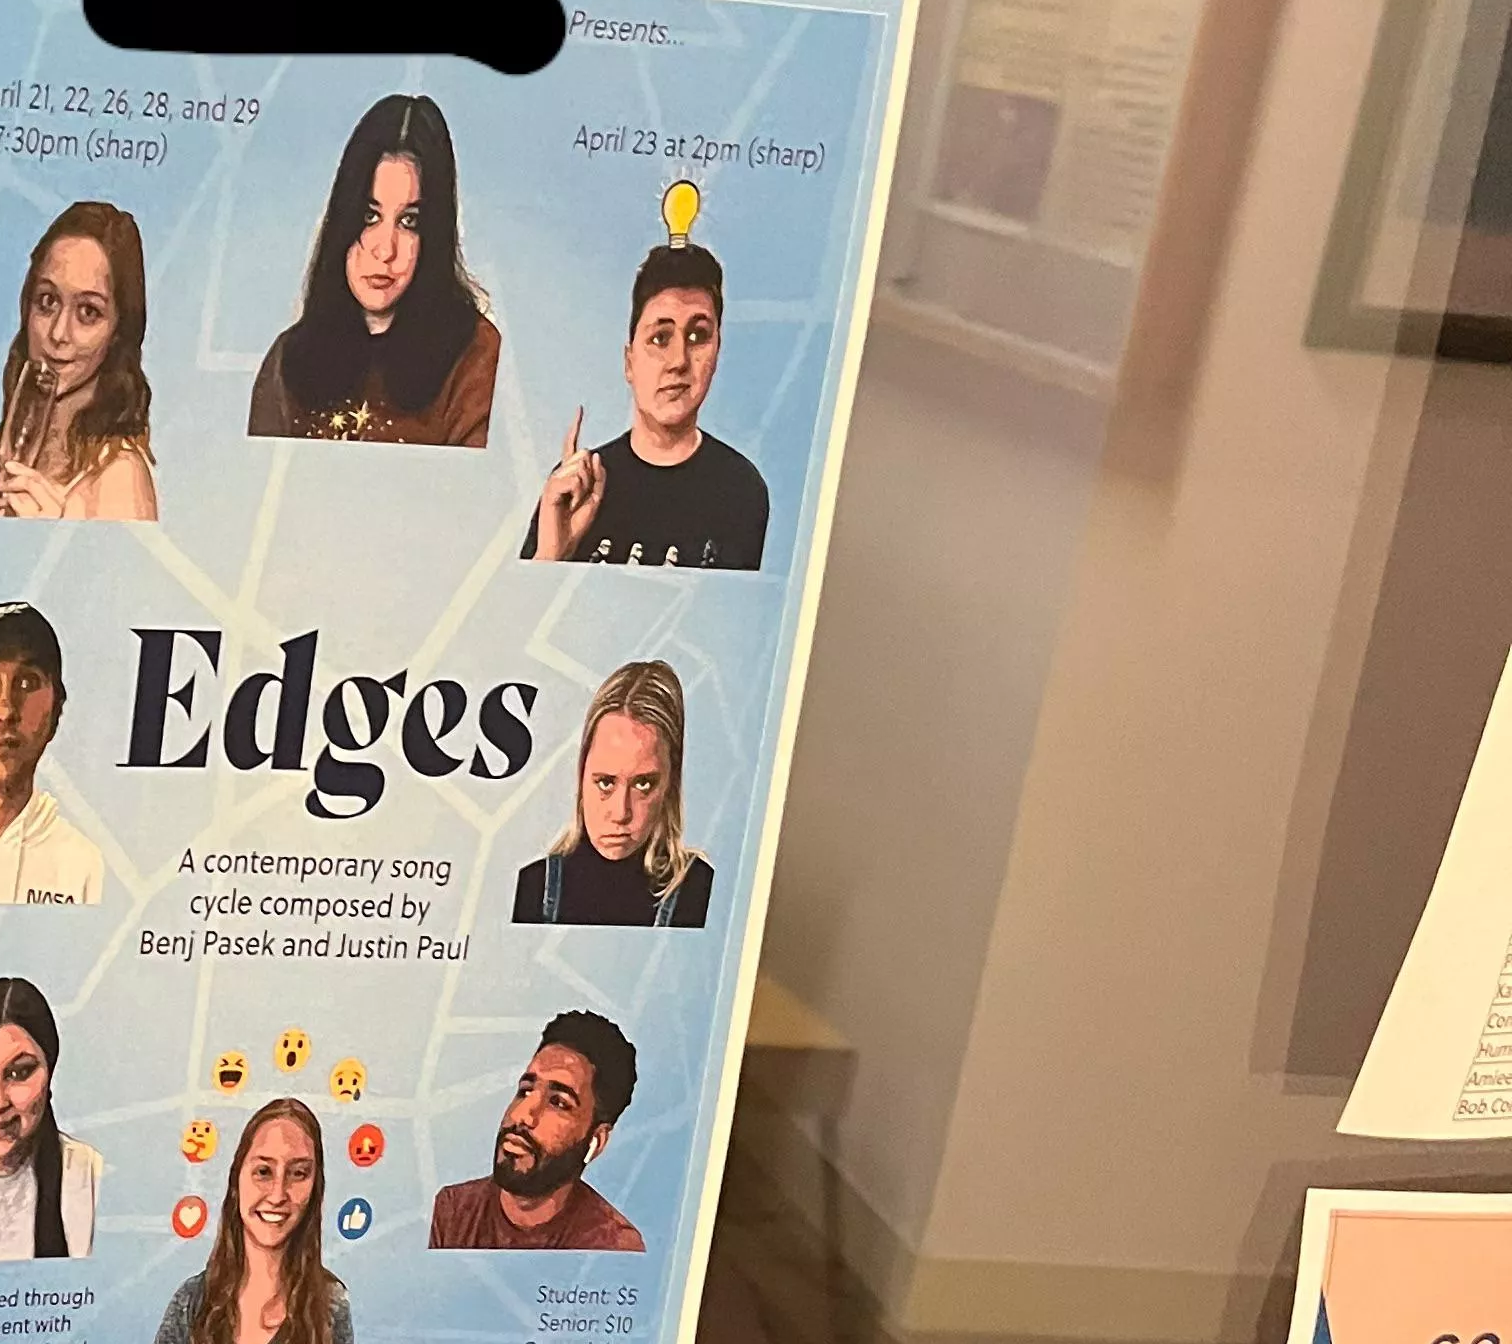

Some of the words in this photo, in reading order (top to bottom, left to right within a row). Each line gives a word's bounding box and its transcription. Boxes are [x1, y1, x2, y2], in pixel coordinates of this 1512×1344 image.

[569, 10, 685, 47] Presents...
[29, 84, 54, 113] 21,
[64, 86, 93, 116] 22,
[103, 88, 132, 119] 26,
[142, 91, 172, 122] 28,
[182, 95, 227, 122] and
[232, 97, 260, 126] 29
[87, 129, 168, 168] (sharp)
[573, 124, 625, 157] April
[632, 130, 657, 155] 23
[664, 136, 686, 158] at
[690, 136, 742, 167] 2pm
[748, 136, 825, 174] (sharp)
[115, 627, 539, 819] Edges
[178, 848, 195, 875] A
[204, 850, 384, 884] contemporary
[390, 858, 452, 887] song
[190, 888, 252, 923] cycle
[259, 891, 392, 924] composed
[401, 894, 431, 925] by
[140, 929, 195, 961] Benj
[203, 929, 274, 956] Pasek
[282, 930, 329, 957] and
[335, 932, 408, 959] Justin
[416, 934, 469, 961] Paul
[1458, 1098, 1487, 1114] Bob
[24, 1286, 94, 1311] through
[537, 1284, 610, 1306] Student:
[616, 1286, 639, 1307] $5
[35, 1315, 71, 1334] with
[537, 1313, 599, 1333] Senior:
[604, 1314, 633, 1334] $10
